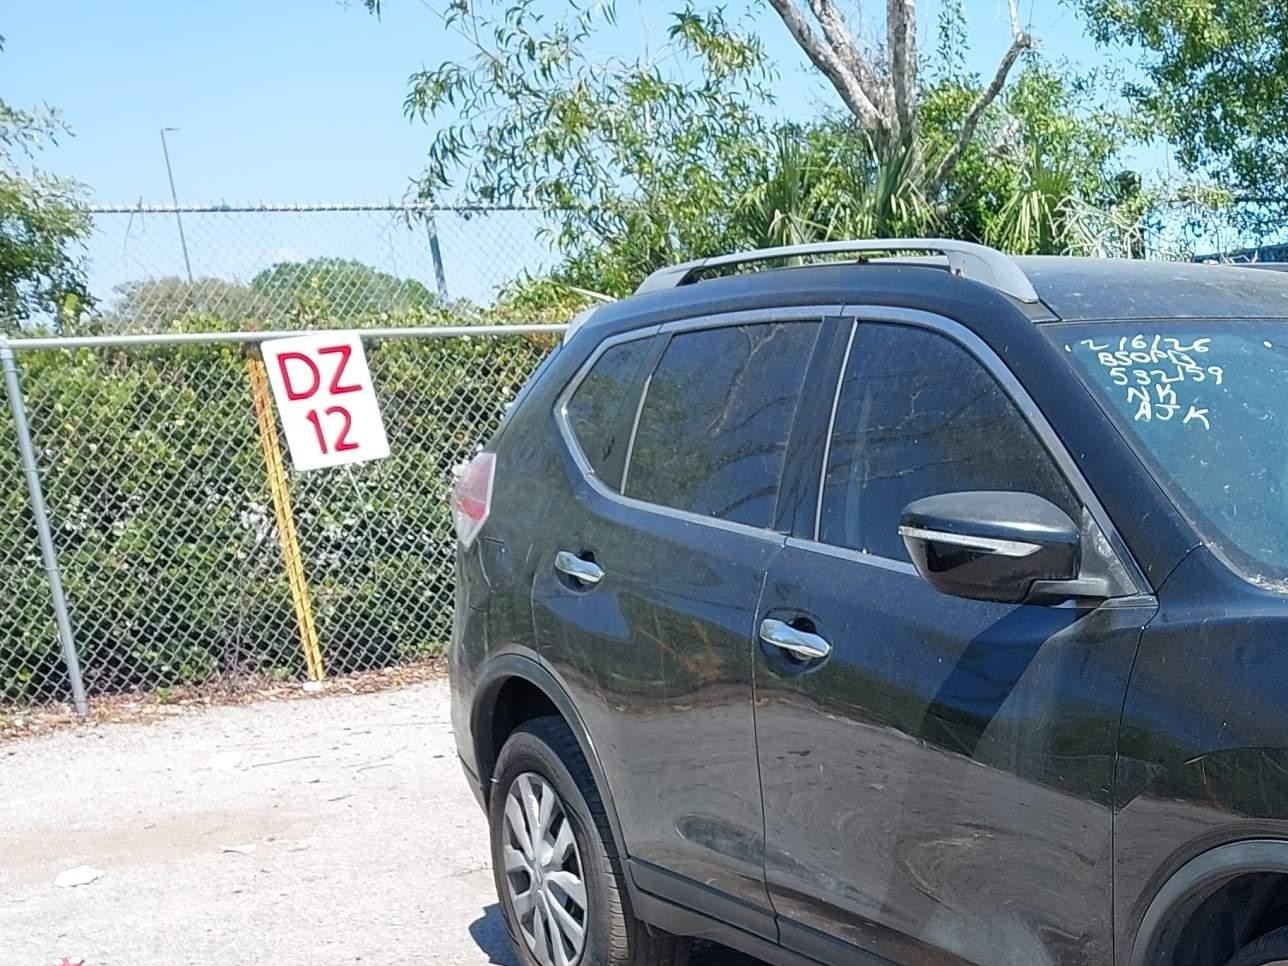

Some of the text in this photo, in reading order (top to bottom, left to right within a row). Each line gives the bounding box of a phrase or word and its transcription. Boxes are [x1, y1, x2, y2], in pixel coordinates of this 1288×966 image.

[276, 344, 363, 401] DZ
[1110, 365, 1224, 385] 532159
[306, 406, 360, 454] 12
